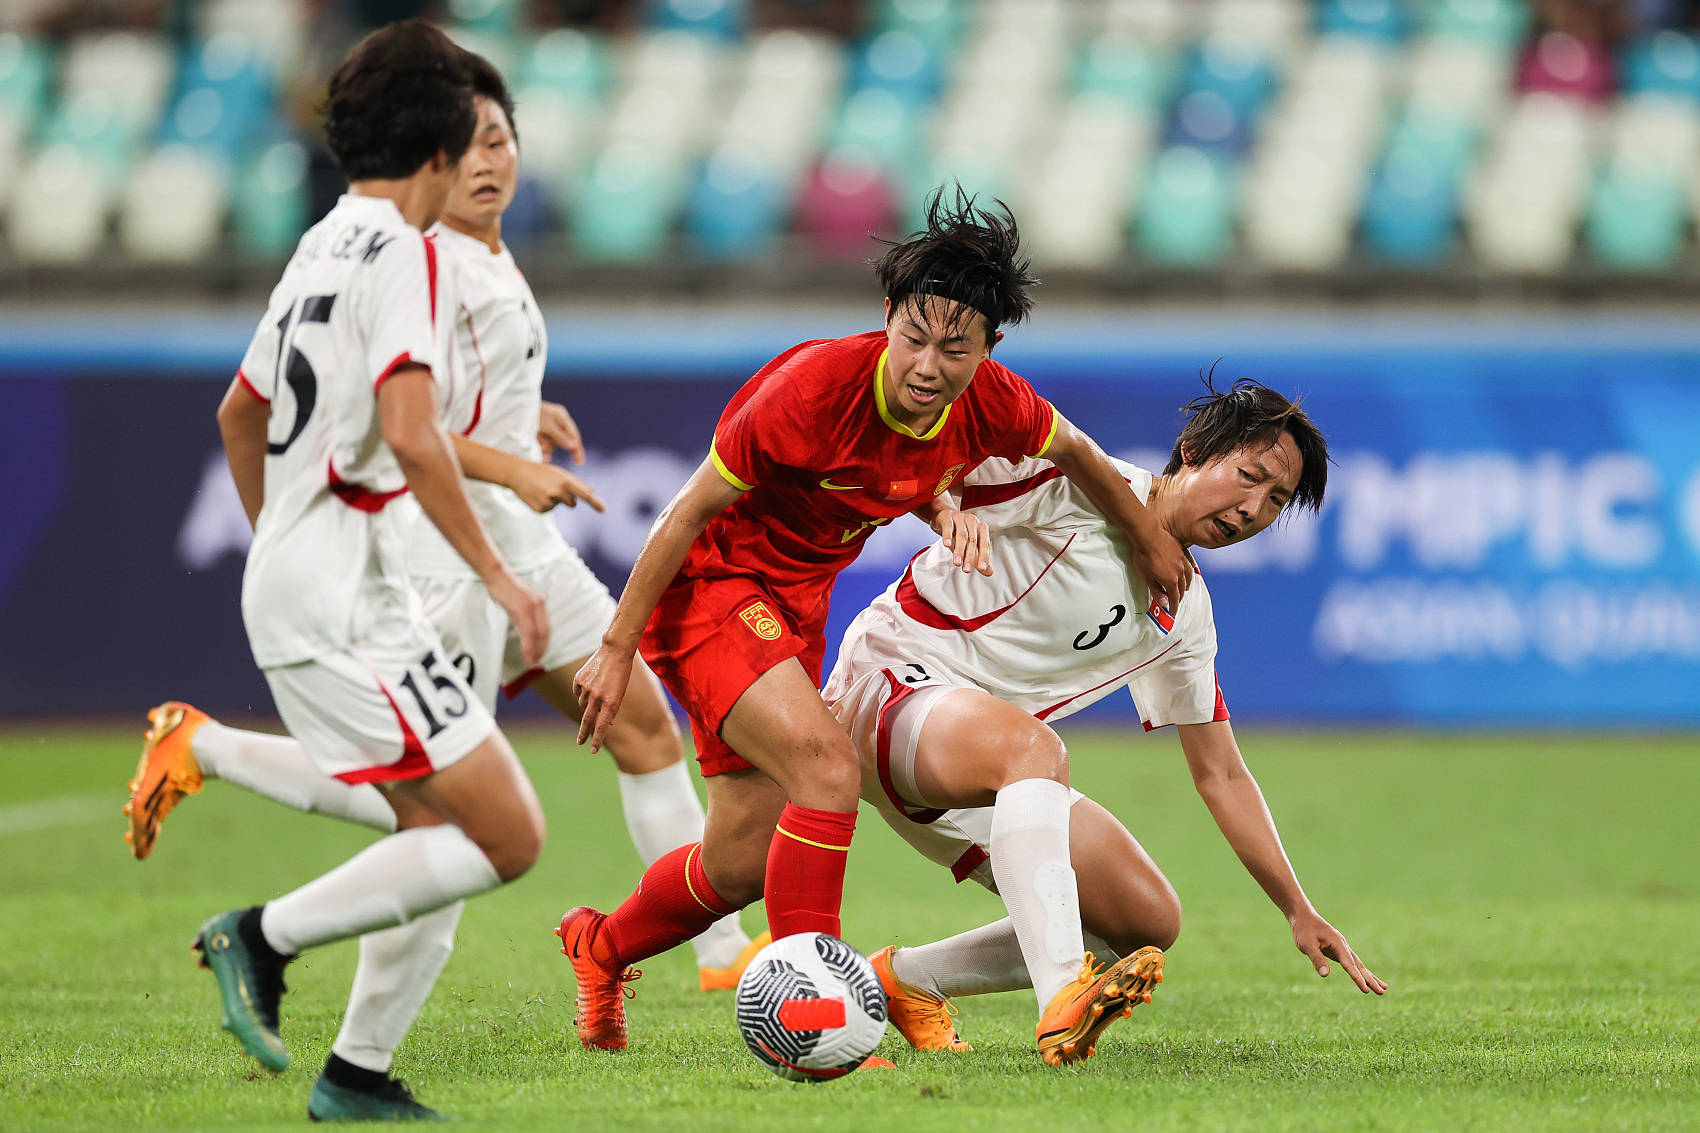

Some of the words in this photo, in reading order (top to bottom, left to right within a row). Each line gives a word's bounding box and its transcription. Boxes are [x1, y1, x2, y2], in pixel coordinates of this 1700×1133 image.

[267, 293, 338, 455] 15
[1073, 604, 1126, 650] 3
[399, 649, 468, 740] 15
